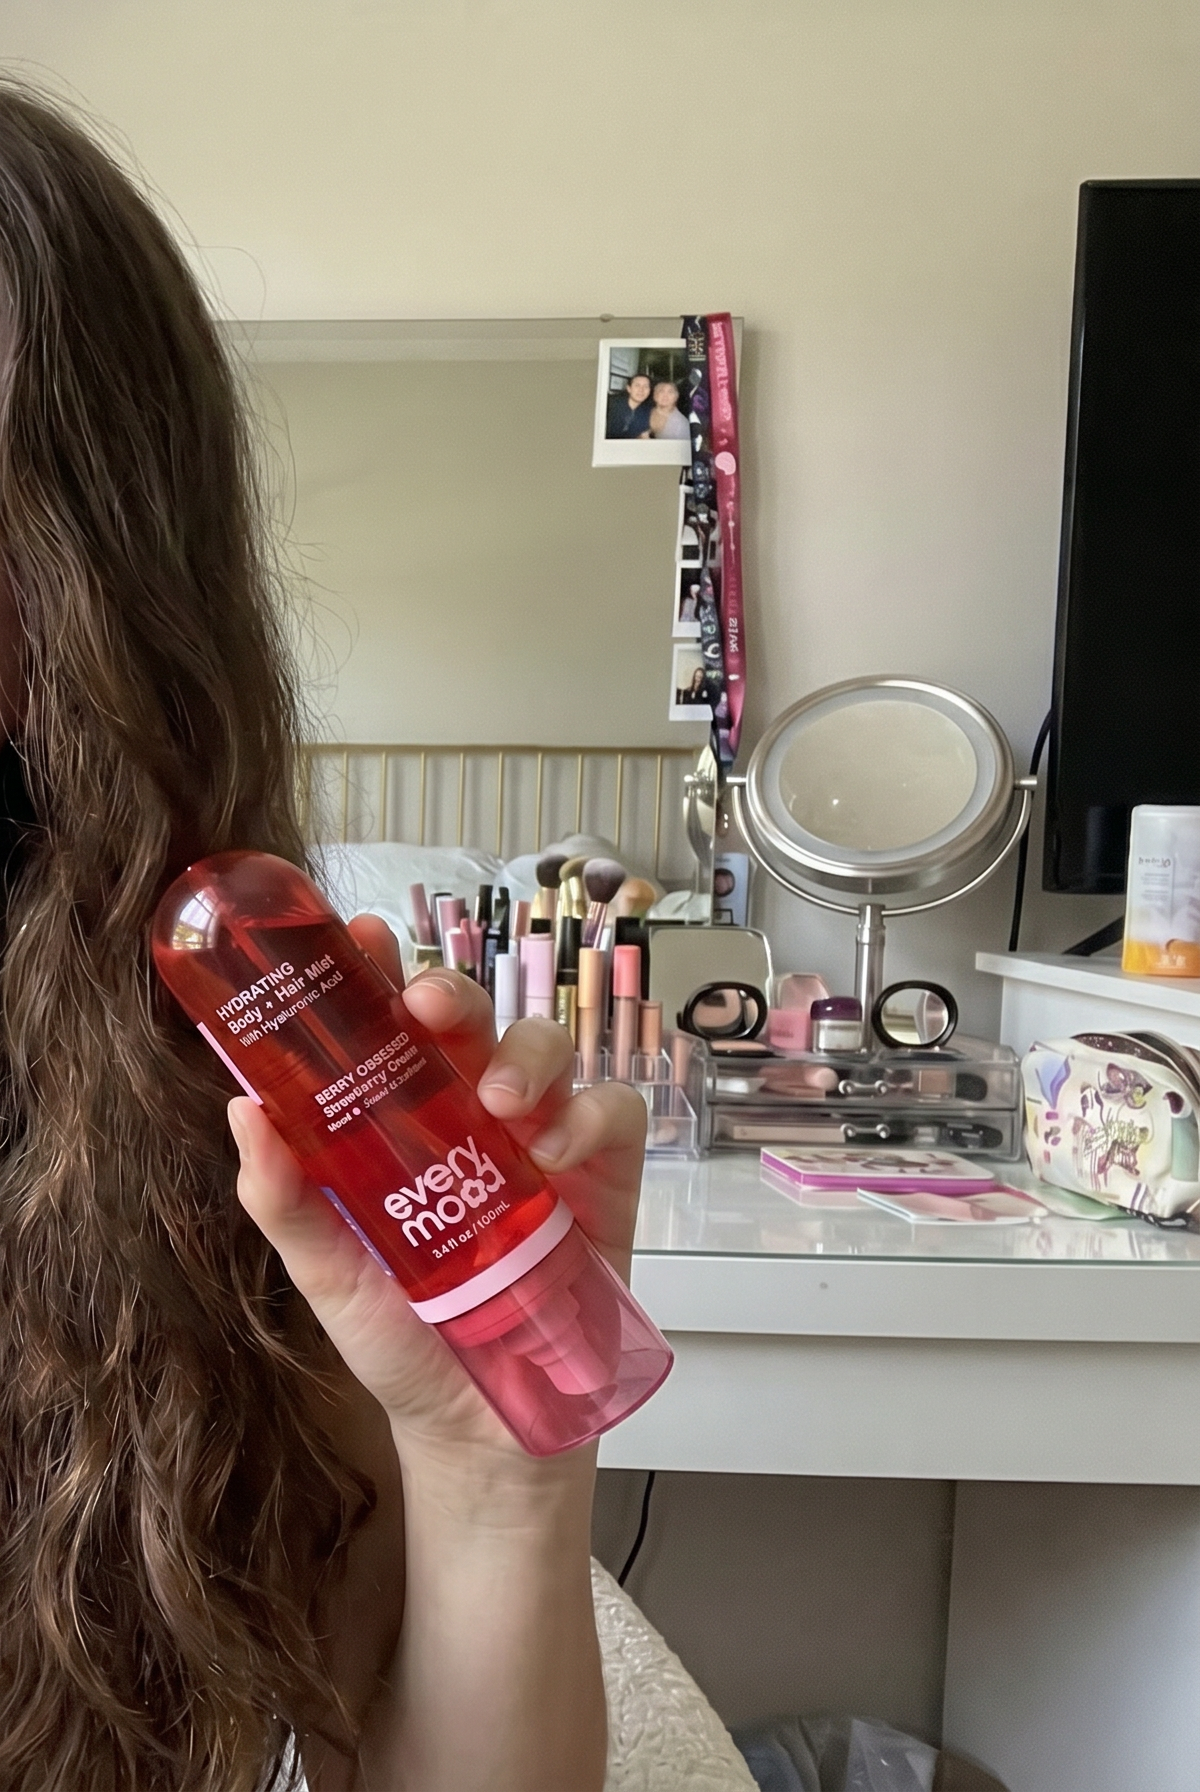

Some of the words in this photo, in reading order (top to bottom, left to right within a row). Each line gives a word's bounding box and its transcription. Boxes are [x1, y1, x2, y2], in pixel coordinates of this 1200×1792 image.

[216, 962, 294, 1020] HYDRATING
[227, 1007, 262, 1034] Body
[274, 977, 306, 1002] Hair
[315, 1072, 355, 1105] BERRY
[357, 1032, 409, 1076] OBSESSED
[384, 1136, 484, 1220] every
[402, 1152, 506, 1247] mood
